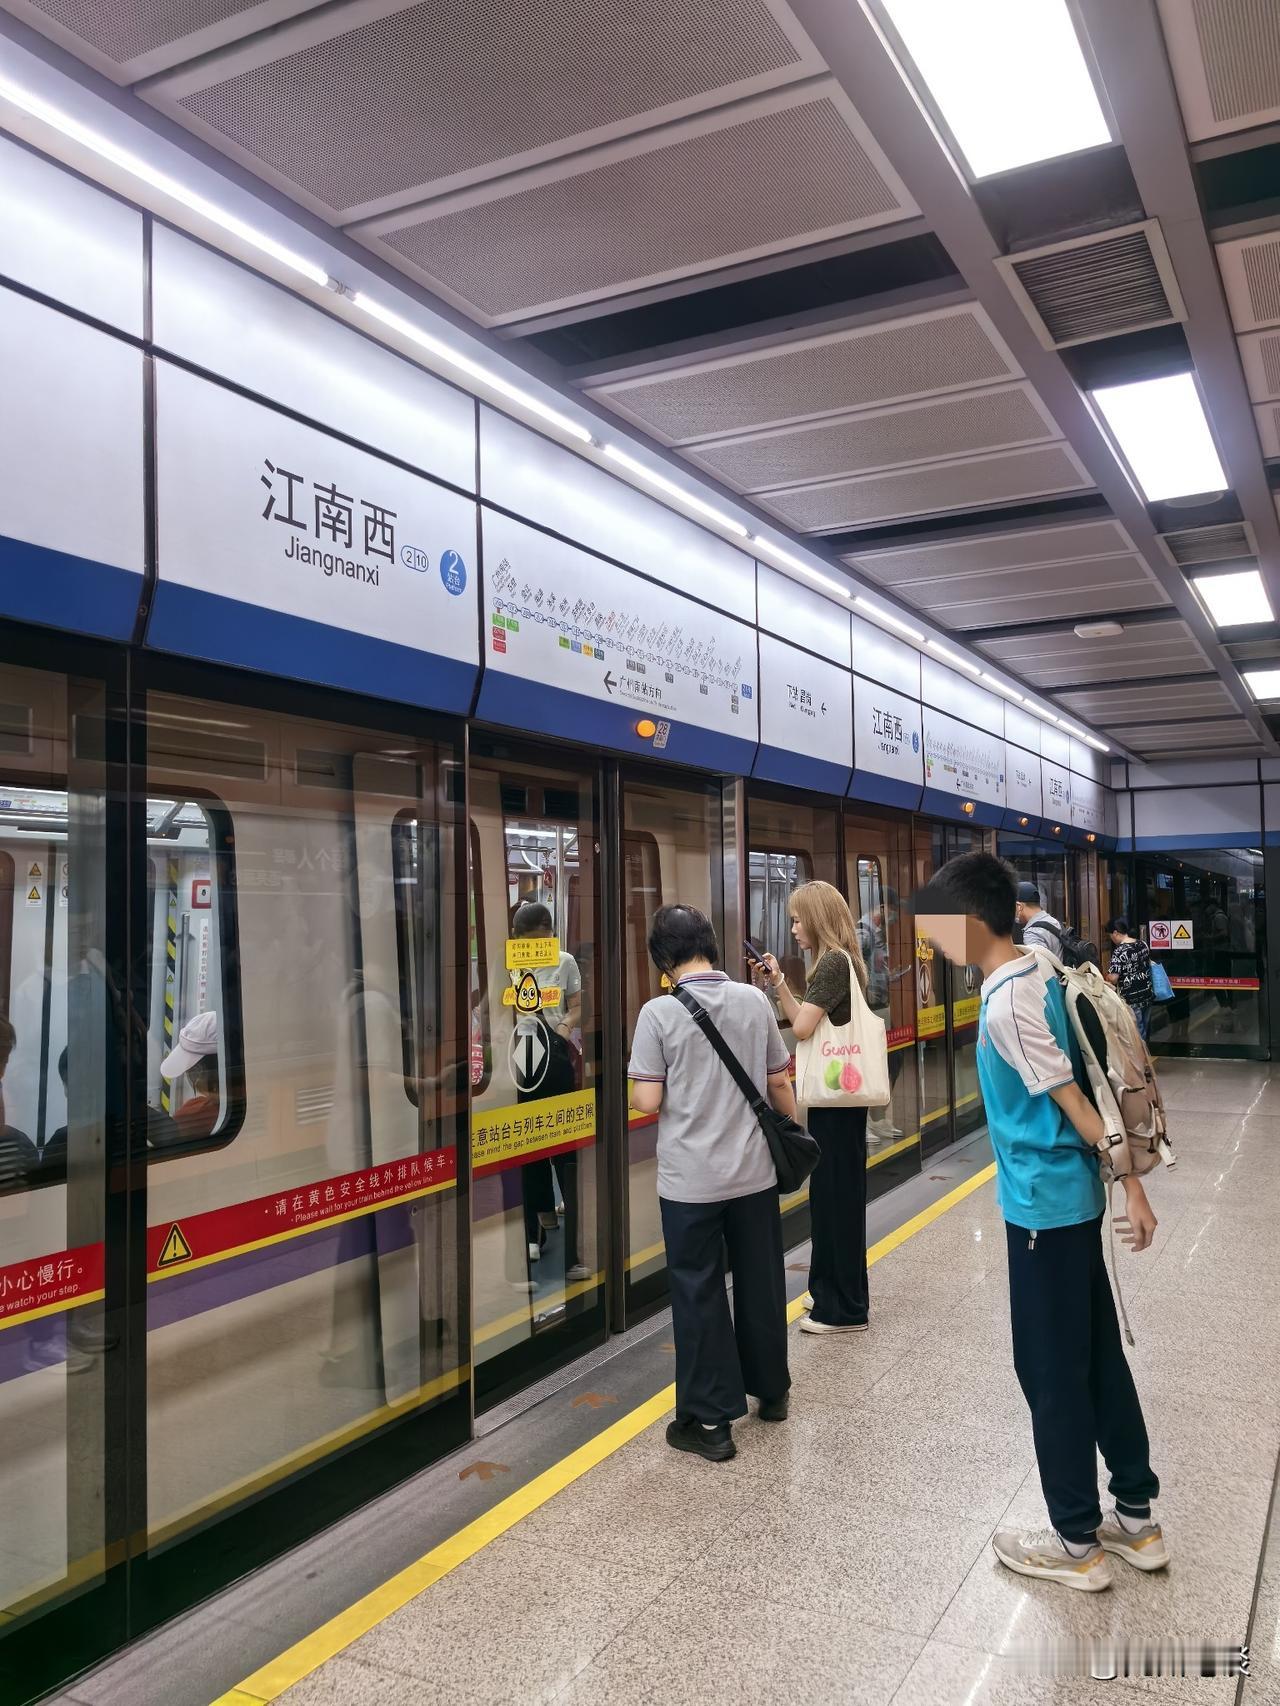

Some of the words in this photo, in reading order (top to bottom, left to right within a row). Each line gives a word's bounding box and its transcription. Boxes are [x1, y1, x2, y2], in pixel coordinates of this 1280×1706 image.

[261, 458, 397, 564] 江南西
[285, 536, 380, 586] Jiangnanxi
[449, 551, 459, 575] 2
[872, 706, 902, 743] 江南西
[822, 1040, 861, 1057] Guava
[295, 1210, 319, 1223] Please
[319, 1205, 334, 1216] wait
[334, 1203, 344, 1213] for
[344, 1199, 359, 1211] your
[373, 1186, 394, 1200] behind
[394, 1184, 404, 1195] the
[6, 1295, 35, 1310] watch
[35, 1289, 59, 1305] your
